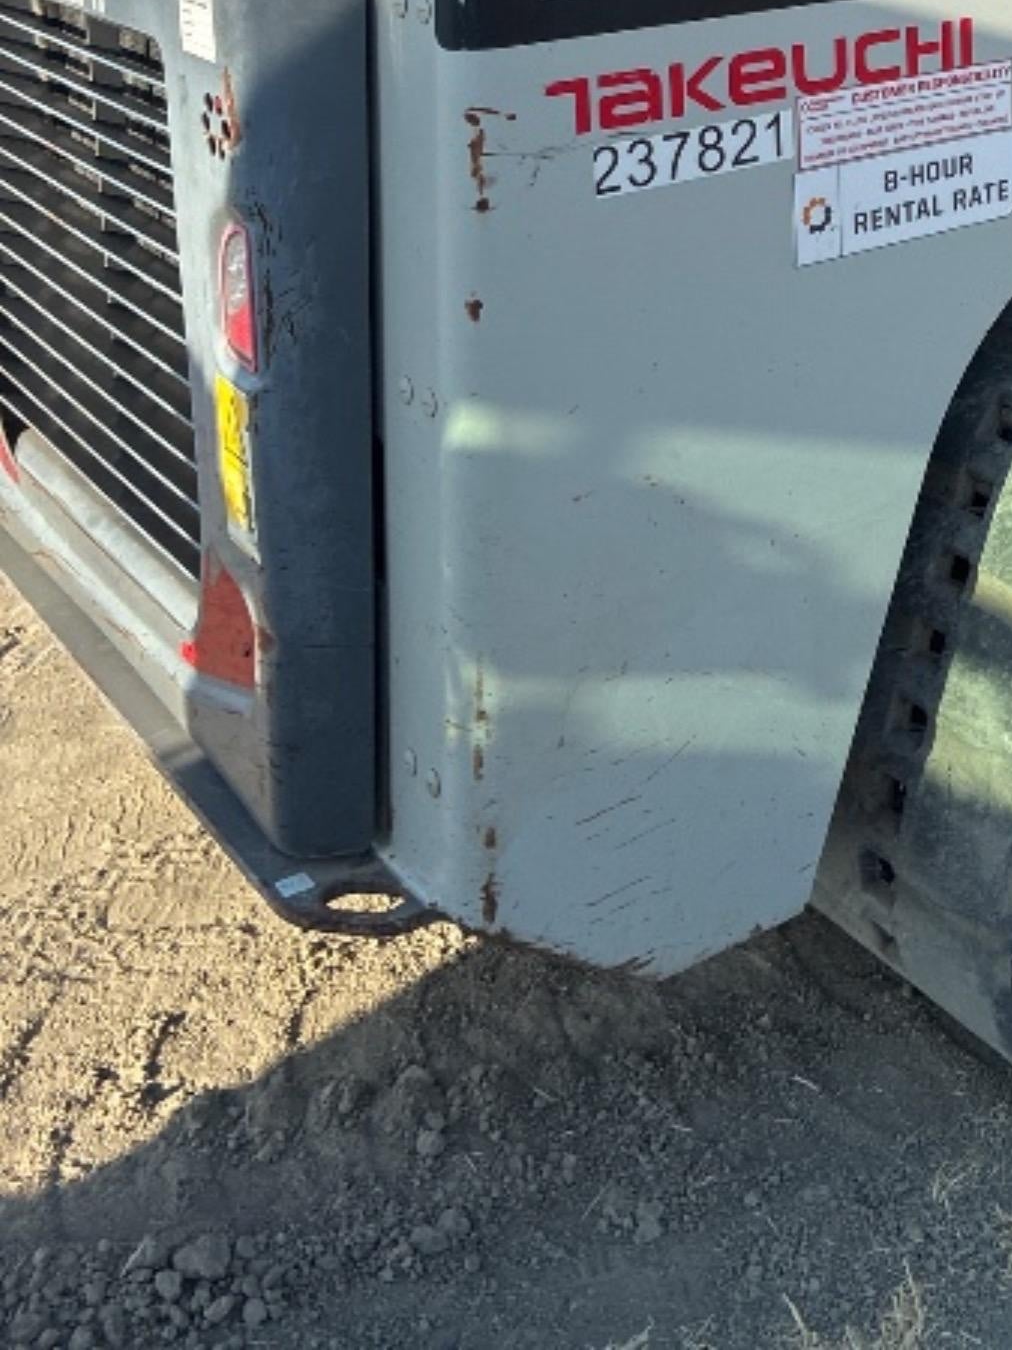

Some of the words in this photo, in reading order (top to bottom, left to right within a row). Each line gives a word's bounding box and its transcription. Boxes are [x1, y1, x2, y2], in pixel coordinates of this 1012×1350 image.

[594, 112, 785, 196] 237821
[884, 153, 973, 193] 8-HOUR
[854, 195, 944, 235] RENTAL
[952, 180, 1009, 212] RATE
